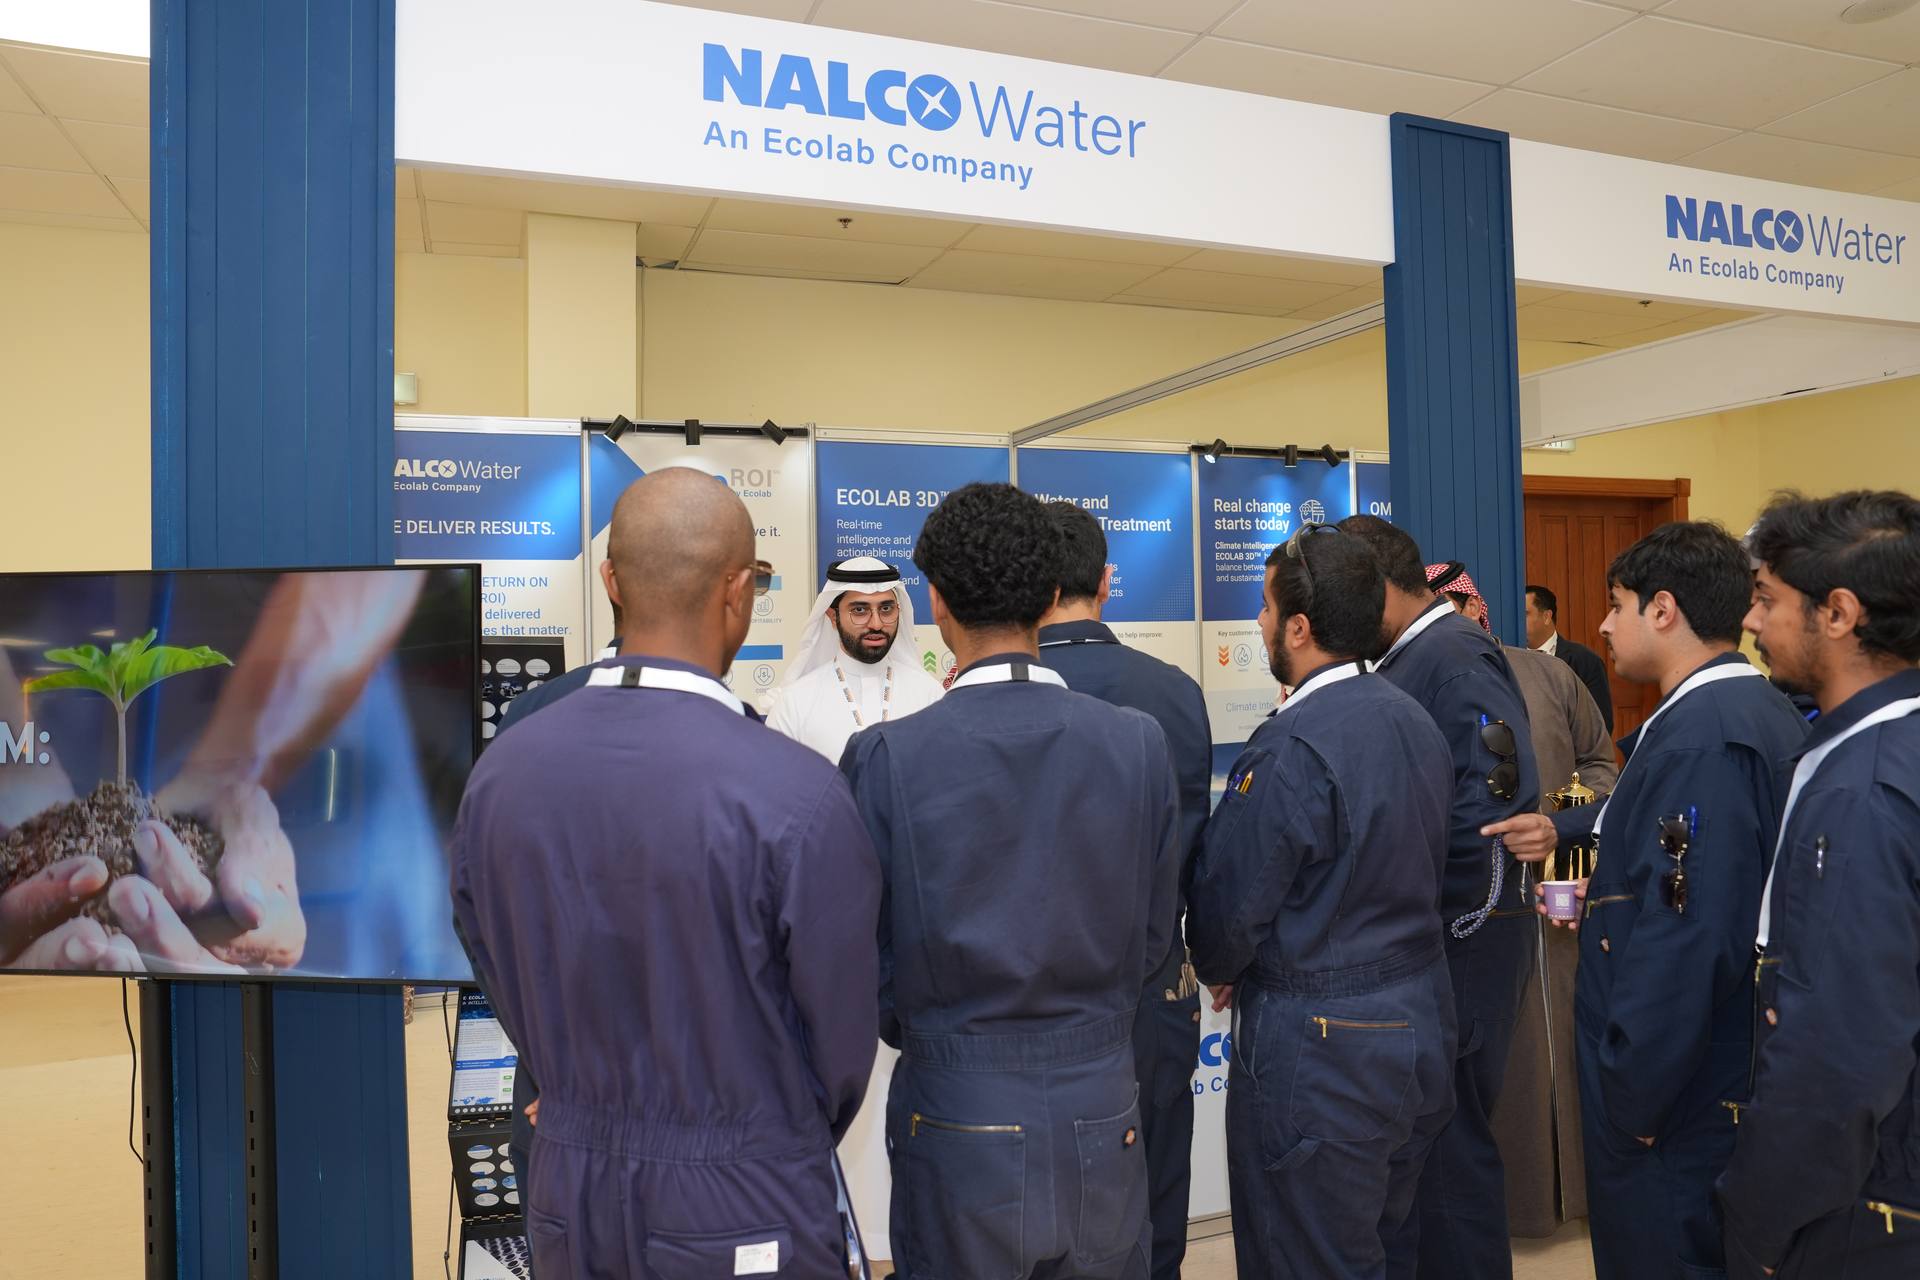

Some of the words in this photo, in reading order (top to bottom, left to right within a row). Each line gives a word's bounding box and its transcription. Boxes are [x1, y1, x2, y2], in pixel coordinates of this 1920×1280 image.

[703, 42, 961, 131] NALCO
[969, 80, 1146, 158] Water
[703, 121, 748, 150] An
[764, 128, 875, 164] Ecolab
[887, 143, 1033, 190] Company
[1665, 194, 1804, 253] NALCO
[1807, 213, 1906, 264] Water
[1669, 252, 1692, 273] An
[1700, 256, 1759, 281] Ecolab
[1766, 264, 1844, 294] Company
[394, 458, 457, 478] ALCO
[459, 460, 521, 480] Water
[714, 468, 776, 487] ROI
[394, 481, 428, 491] Ecolab
[432, 482, 481, 493] Company
[836, 488, 910, 507] ECOLAB
[1082, 495, 1108, 509] and
[1214, 498, 1242, 513] Real
[1245, 498, 1291, 516] change
[407, 520, 475, 534] DELIVER
[481, 521, 555, 535] RESULTS.
[836, 519, 883, 530] Real-time
[1098, 516, 1171, 531] Treatment
[1214, 517, 1251, 530] starts
[1255, 517, 1290, 533] today
[836, 534, 891, 547] intelligence
[893, 535, 911, 545] and
[1215, 541, 1241, 550] Climate
[836, 547, 886, 558] actionable
[1216, 552, 1244, 561] ECOLAB
[1216, 563, 1242, 571] balance
[1243, 563, 1267, 571] betwee
[482, 576, 525, 588] ETURN
[529, 576, 548, 588] ON
[902, 576, 920, 585] and
[1216, 574, 1229, 582] and
[1231, 574, 1264, 582] sustainabi
[481, 592, 506, 605] ROI)
[485, 608, 541, 620] delivered
[501, 625, 525, 636] that
[1226, 702, 1257, 713] Climate
